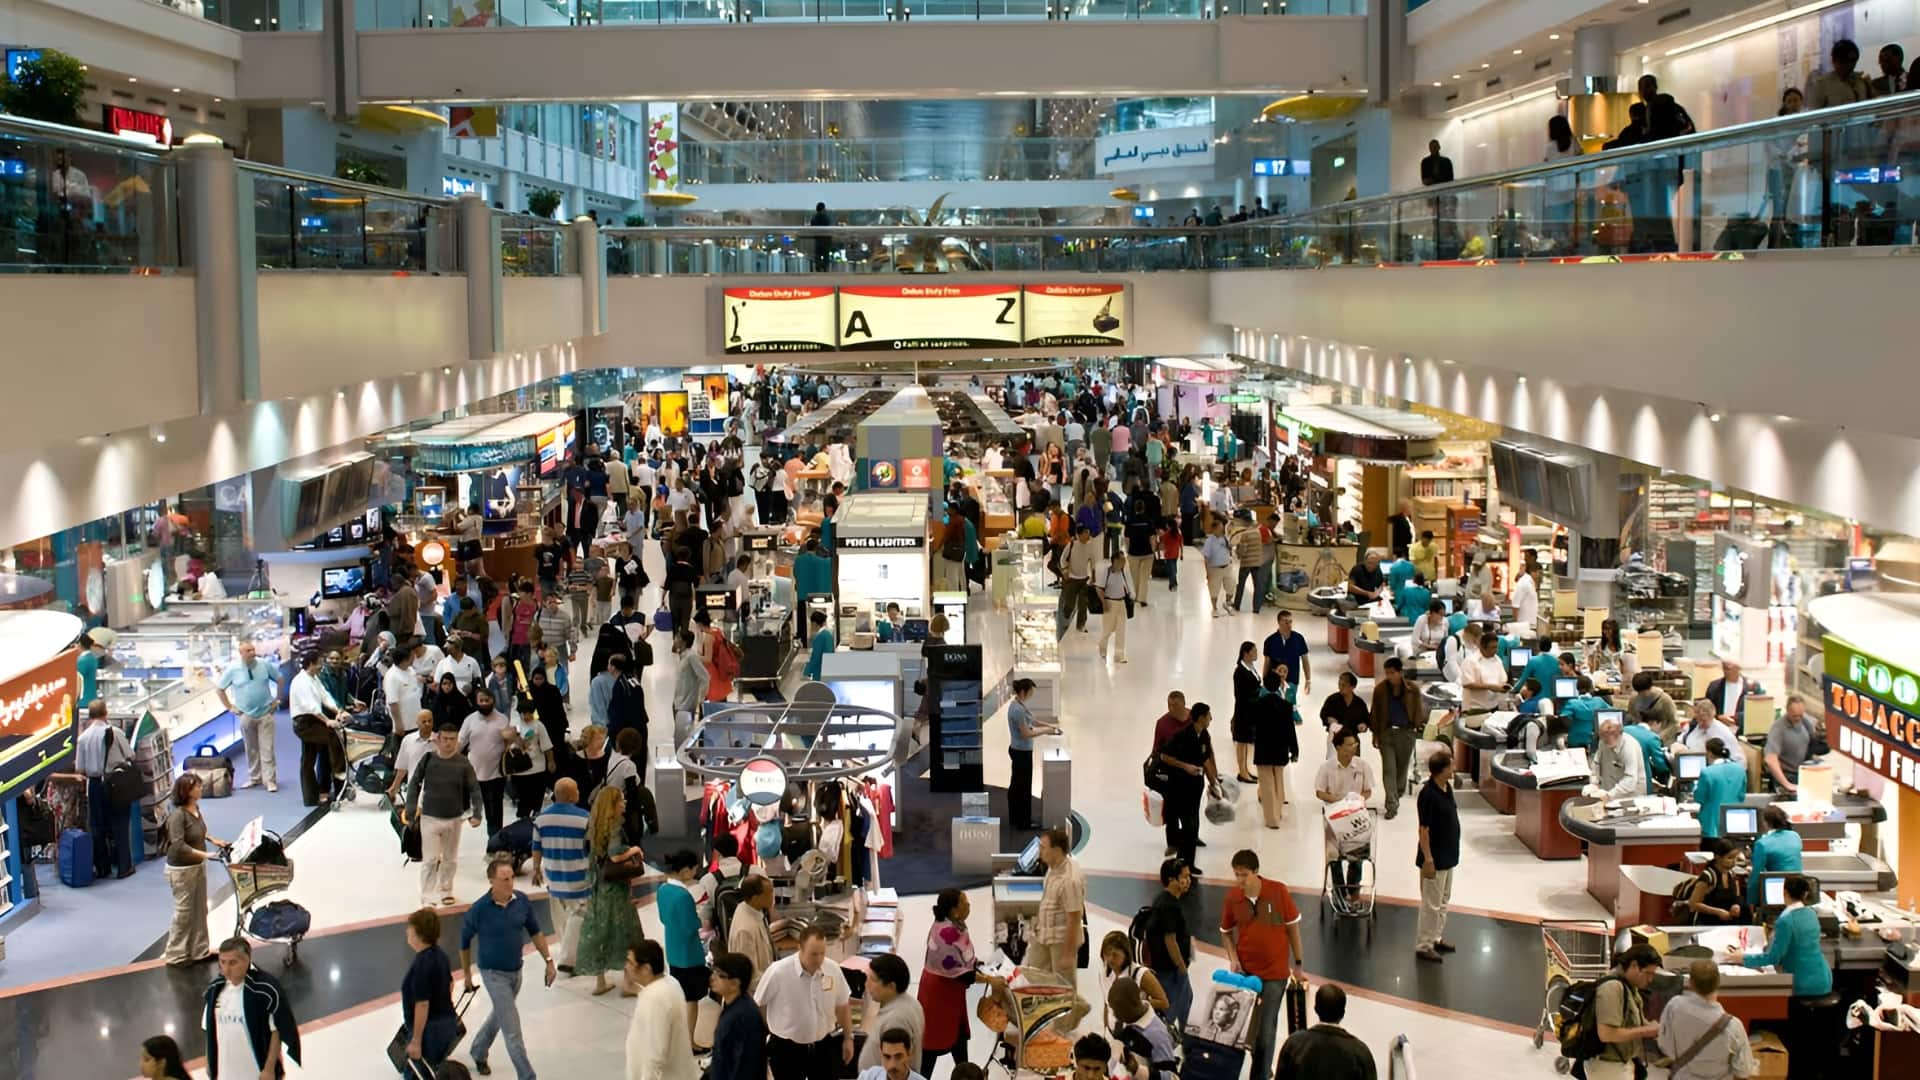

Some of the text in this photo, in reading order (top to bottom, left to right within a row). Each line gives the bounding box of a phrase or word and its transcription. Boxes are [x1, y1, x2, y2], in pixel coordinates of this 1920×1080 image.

[1271, 160, 1286, 175] 17
[844, 310, 873, 338] A
[995, 297, 1016, 325] Z
[845, 537, 917, 547] PENS & LIGHTERS
[1848, 654, 1920, 706] FOO
[1839, 724, 1884, 770] DUTY
